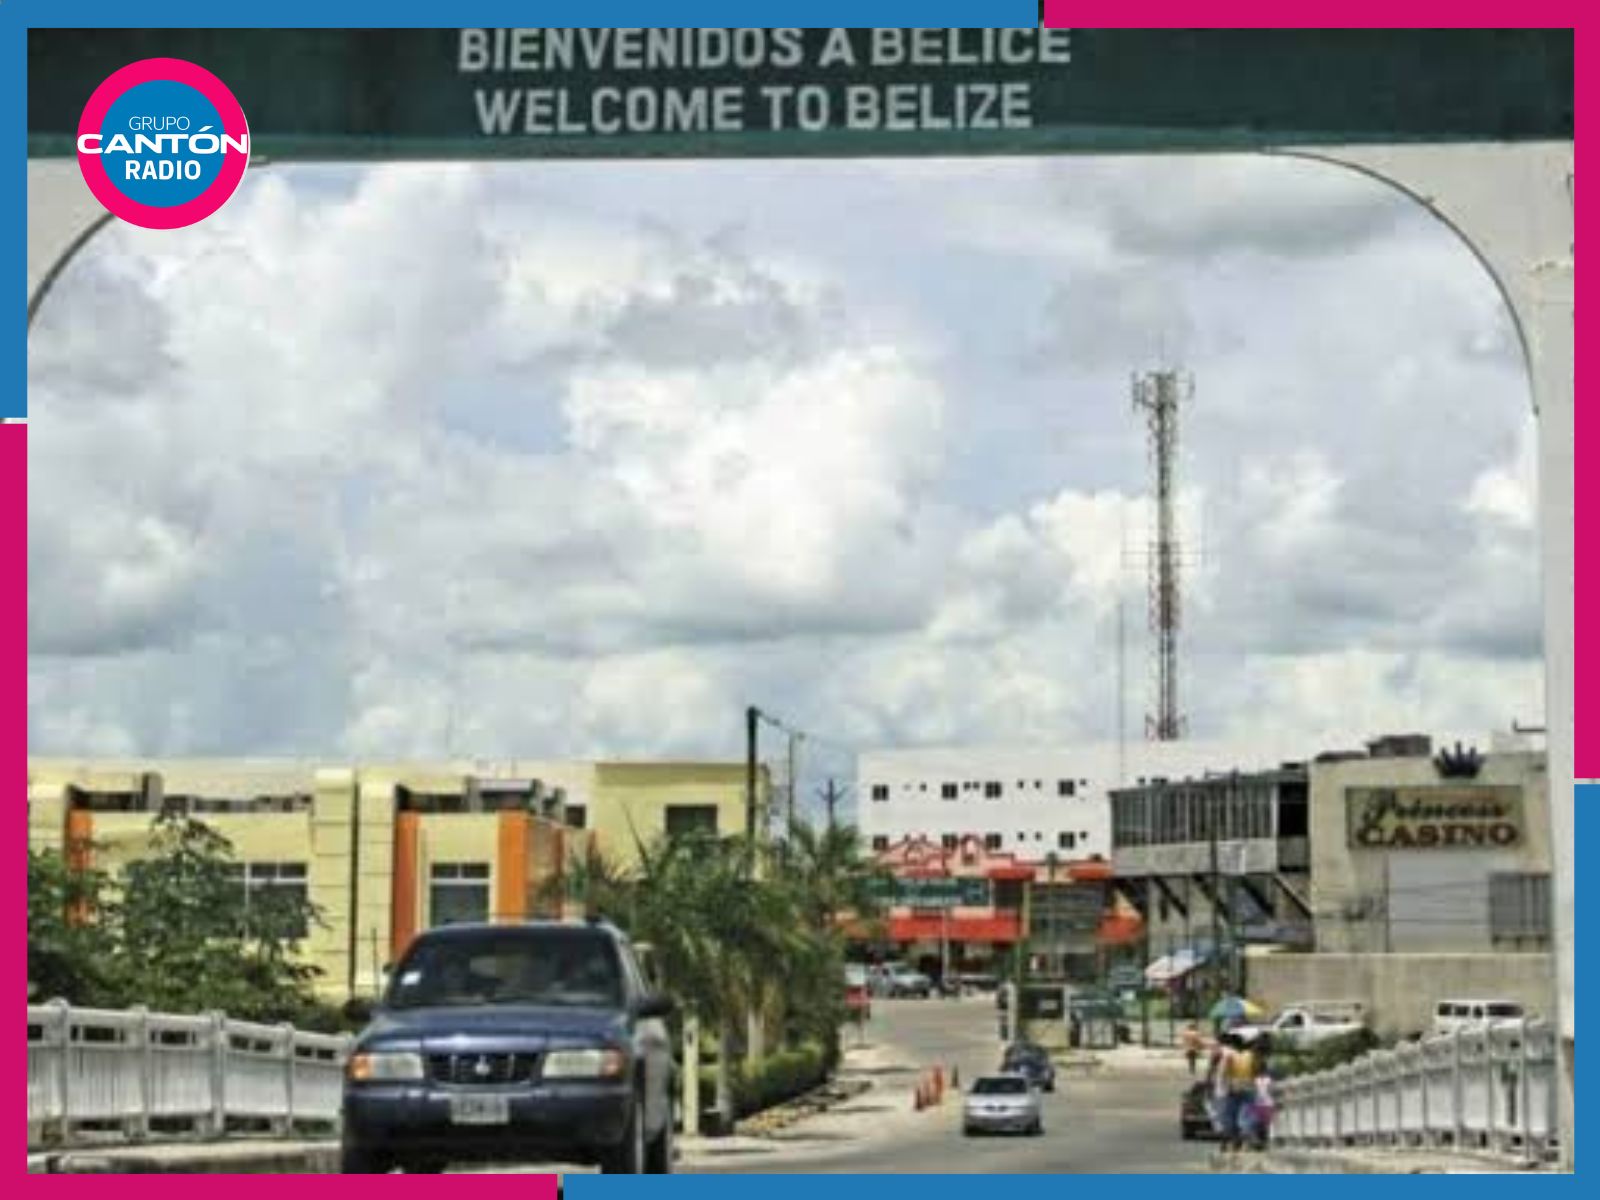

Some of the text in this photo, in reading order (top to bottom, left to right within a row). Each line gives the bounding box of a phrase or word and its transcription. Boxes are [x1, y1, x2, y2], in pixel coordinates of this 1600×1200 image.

[458, 27, 1071, 70] BIENVENIDOS A BELICE
[475, 83, 1033, 134] WELCOME TO BELIZE
[1357, 823, 1518, 845] CASINO
